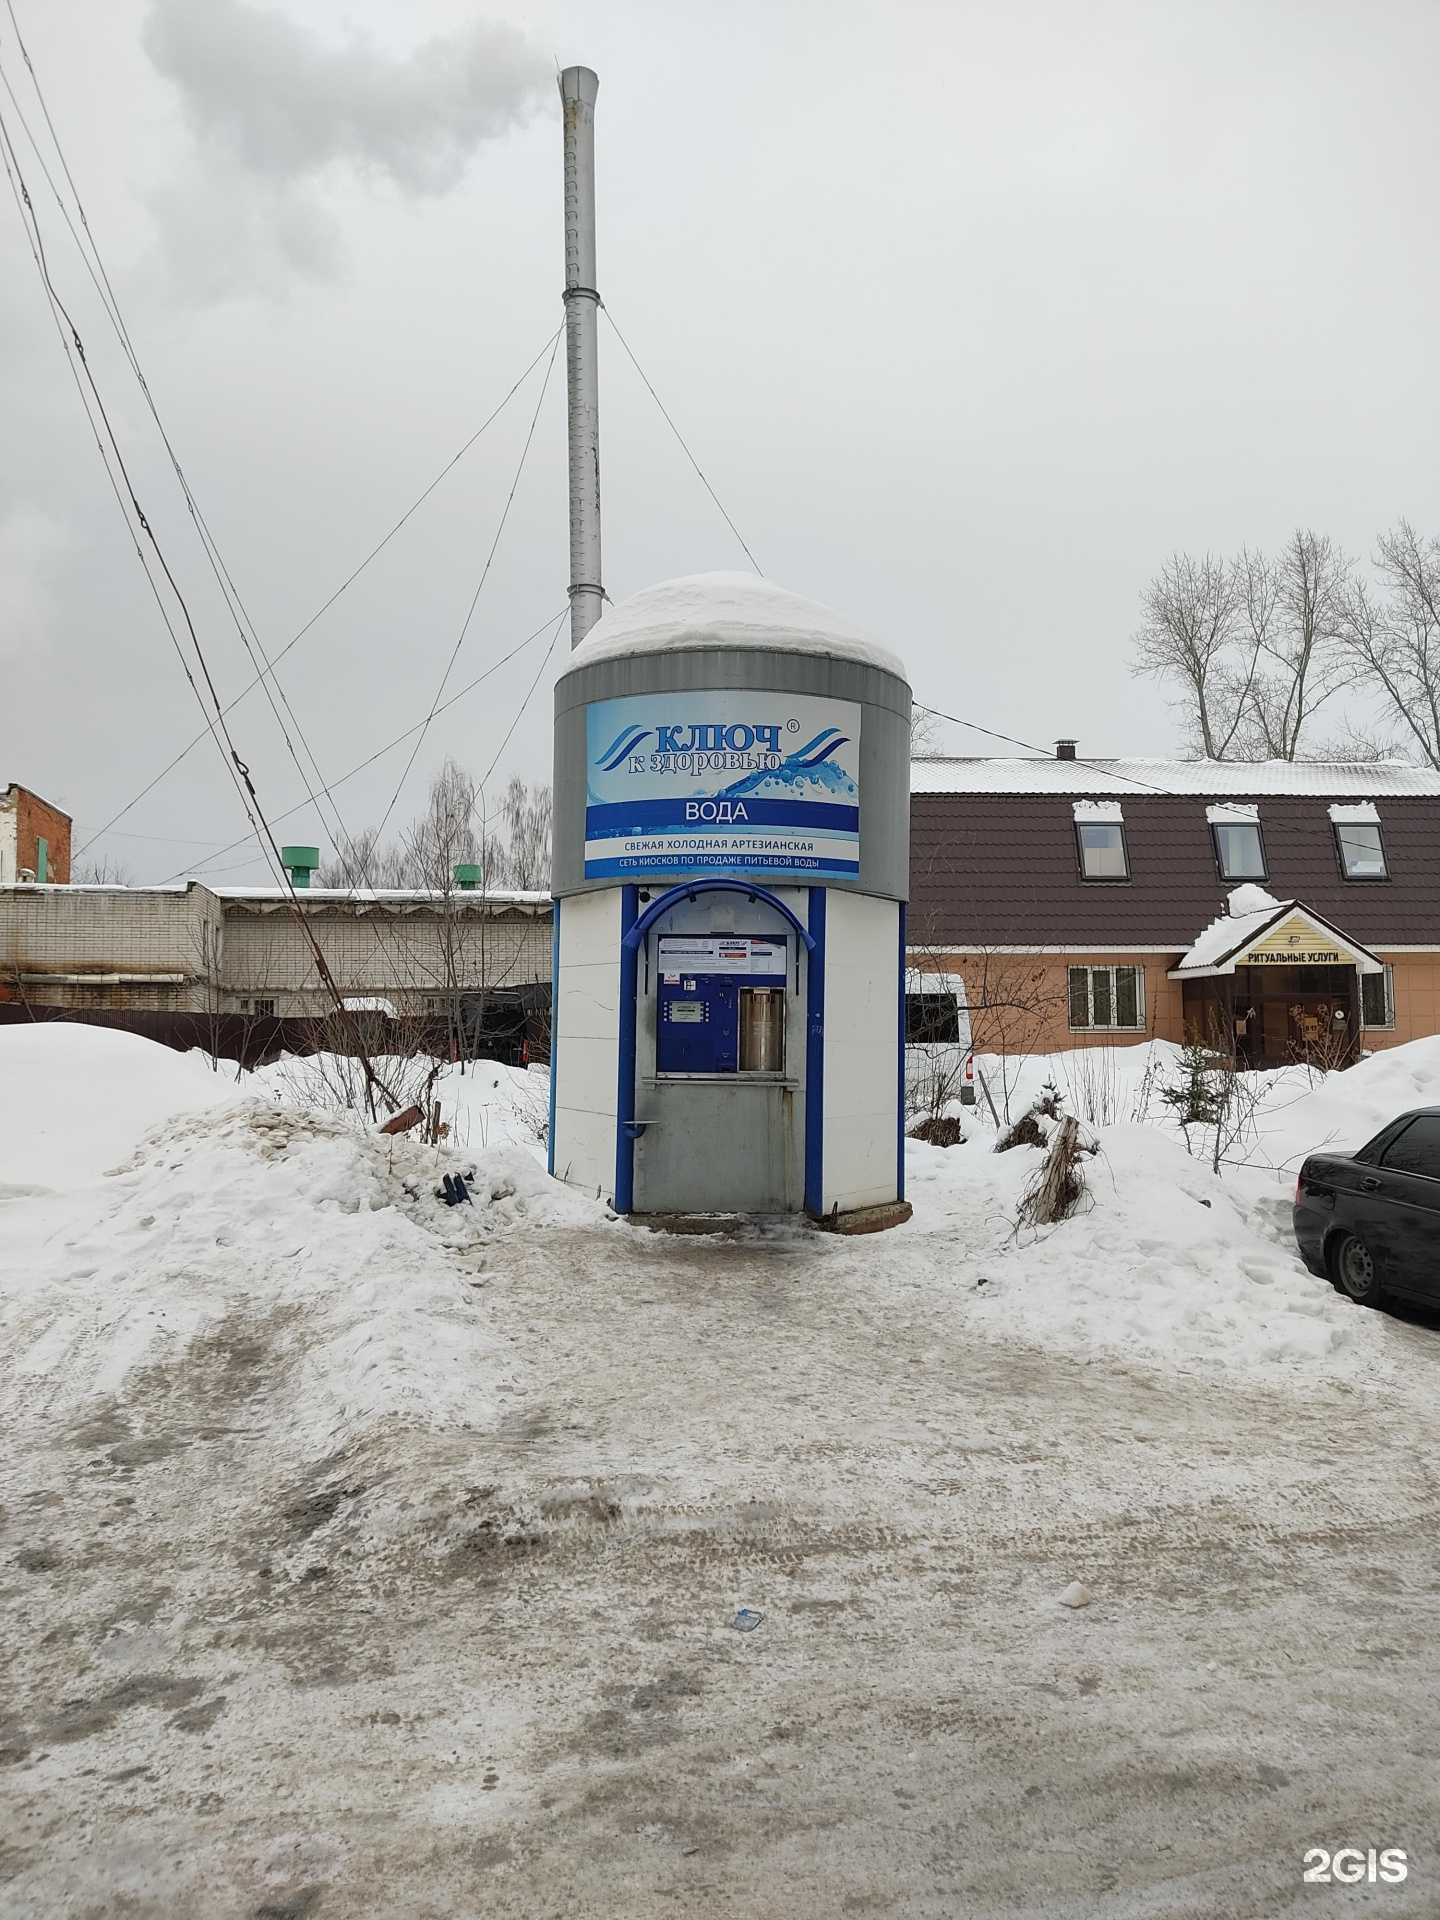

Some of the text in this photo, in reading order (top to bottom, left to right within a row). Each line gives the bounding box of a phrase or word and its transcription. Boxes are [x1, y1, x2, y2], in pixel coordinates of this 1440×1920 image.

[655, 724, 782, 753] КЛЮЧ
[685, 801, 749, 824] ВОДА
[624, 839, 814, 852] СВЕЖАЯ ХОЛОДНАЯ АРТЕЗИАНСКАЯ
[619, 856, 819, 868] СЕТЬ КИОСКОВ ПО ПРОДАЖЕ ПИТЬЕВОЙ ВОДЫ
[1248, 952, 1339, 964] РИТУАЛЬНЫЕ УСЛУГИ
